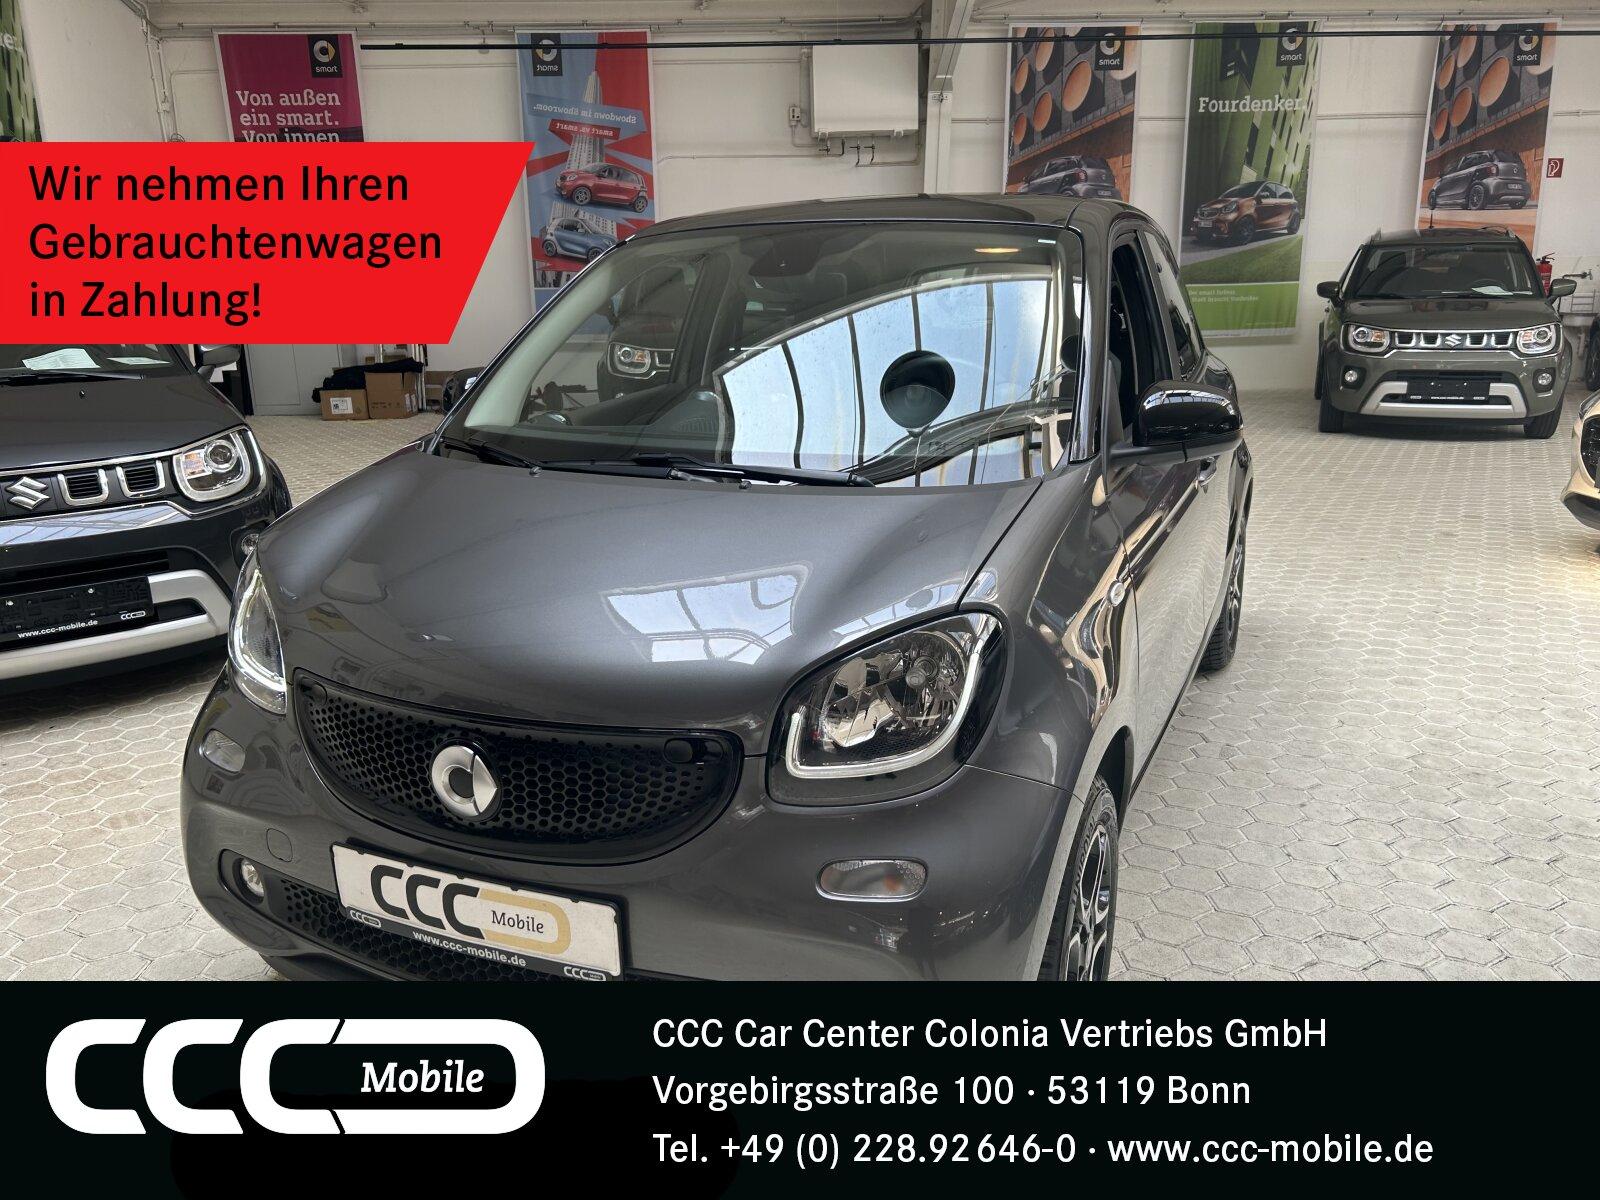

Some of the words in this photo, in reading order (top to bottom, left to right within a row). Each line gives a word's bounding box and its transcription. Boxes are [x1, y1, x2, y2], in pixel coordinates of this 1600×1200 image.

[1099, 58, 1120, 66] smart
[1280, 53, 1303, 61] smart
[1516, 53, 1538, 61] smart
[315, 65, 338, 73] smart
[235, 90, 274, 106] Von
[279, 88, 341, 106] außen
[1198, 94, 1308, 114] Fourdenker.
[239, 108, 271, 126] ein
[276, 110, 339, 126] smart.
[242, 129, 281, 142] Von
[285, 128, 340, 142] innen
[17, 619, 98, 639] www.ccc-mobile.de
[371, 864, 485, 940] CCC
[491, 909, 545, 935] Mobile
[412, 930, 527, 967] www.ccc-mobile.de
